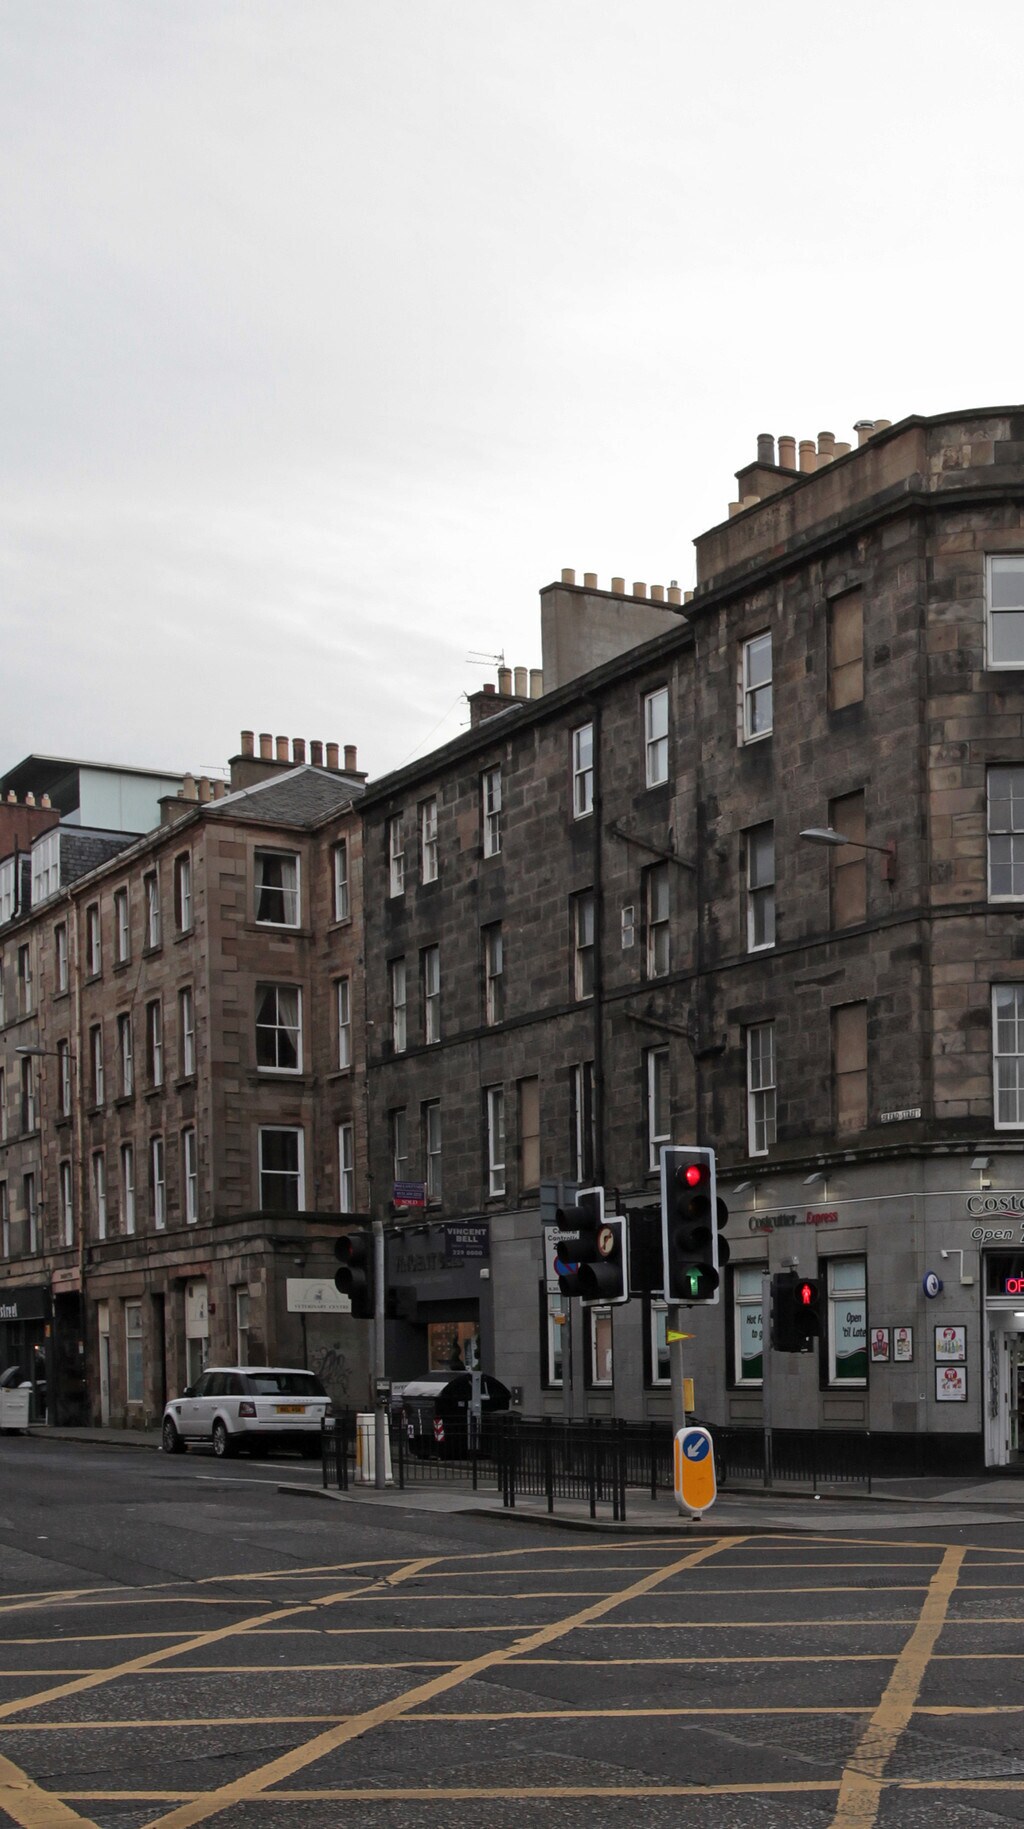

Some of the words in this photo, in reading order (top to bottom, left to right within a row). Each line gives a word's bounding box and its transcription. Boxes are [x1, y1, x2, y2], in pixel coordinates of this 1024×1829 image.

[447, 1228, 487, 1236] VINCENT
[971, 1227, 1013, 1242] Open
[456, 1235, 478, 1243] BELL
[846, 1312, 862, 1323] Open
[853, 1327, 867, 1338] Late
